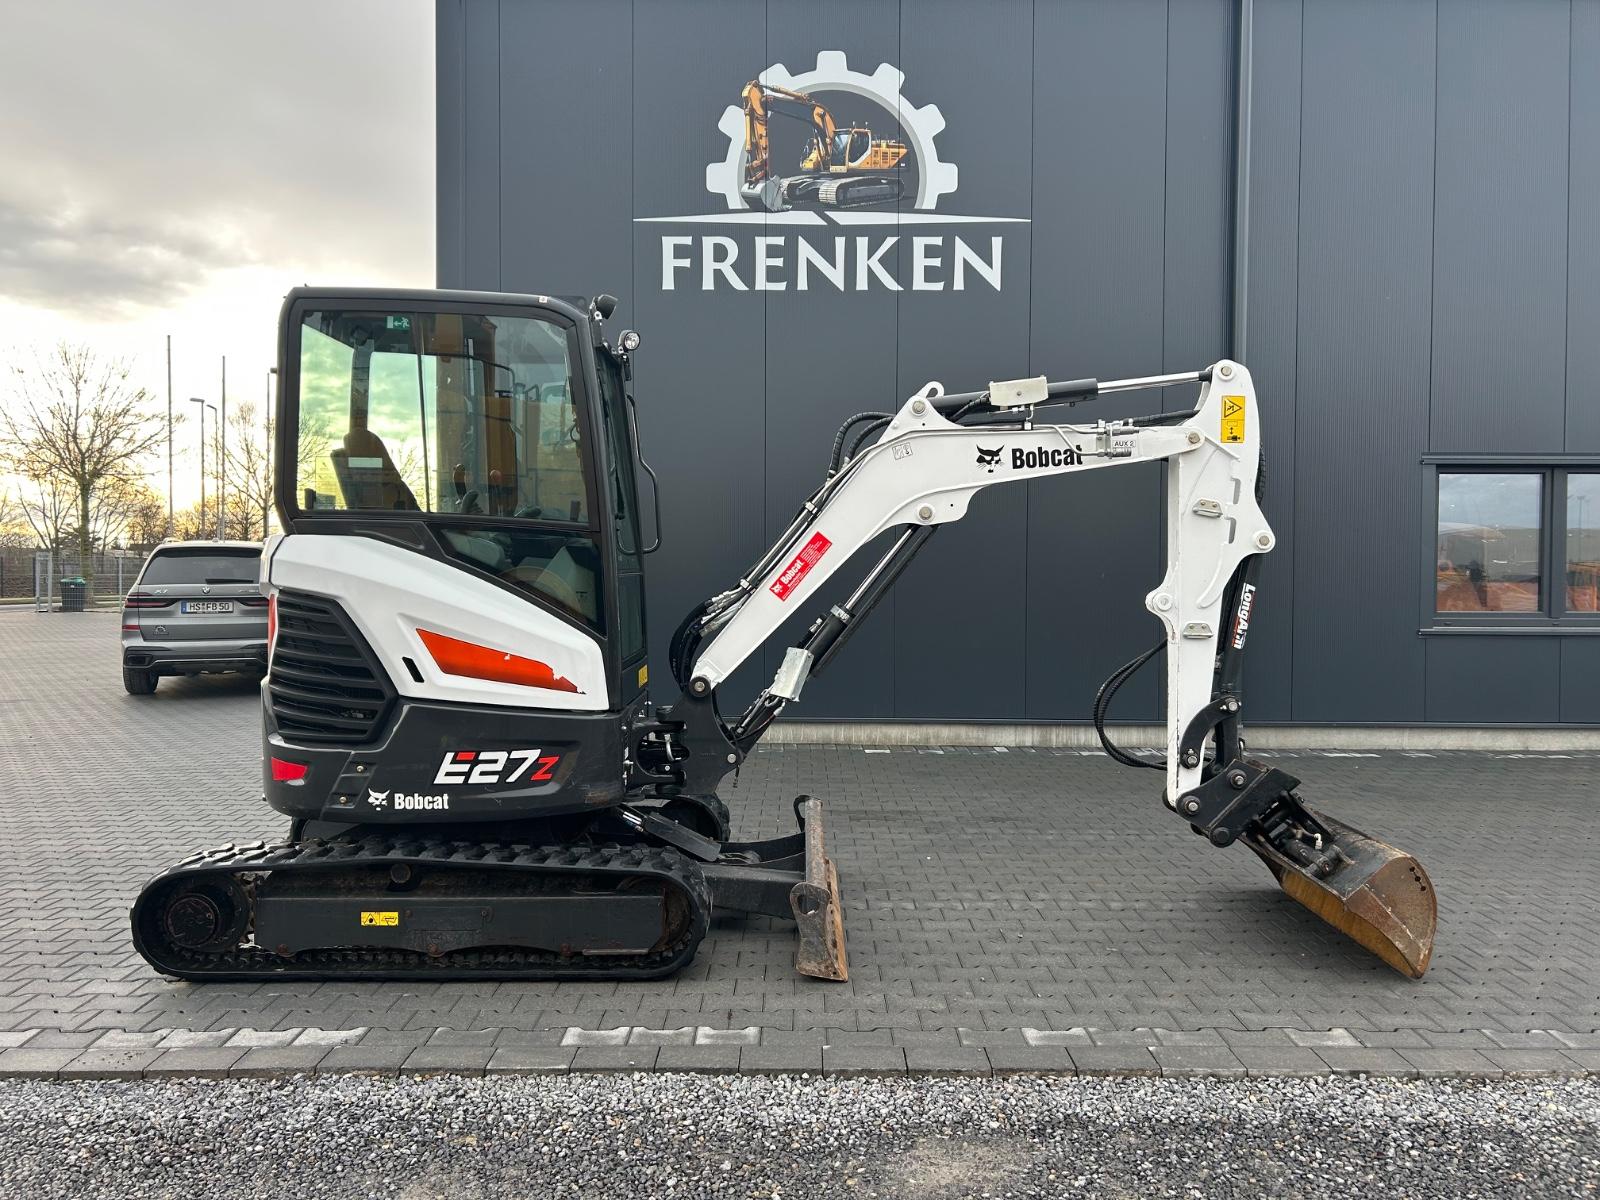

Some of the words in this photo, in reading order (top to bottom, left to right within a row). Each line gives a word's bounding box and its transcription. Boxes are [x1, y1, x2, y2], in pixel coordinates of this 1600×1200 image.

[661, 235, 1003, 292] FRENKEN
[1012, 444, 1083, 470] Bobcat
[780, 559, 804, 585] Bobcat
[189, 603, 200, 611] HS
[206, 602, 217, 611] FB
[219, 602, 230, 610] 50
[394, 793, 449, 810] Bobcat
